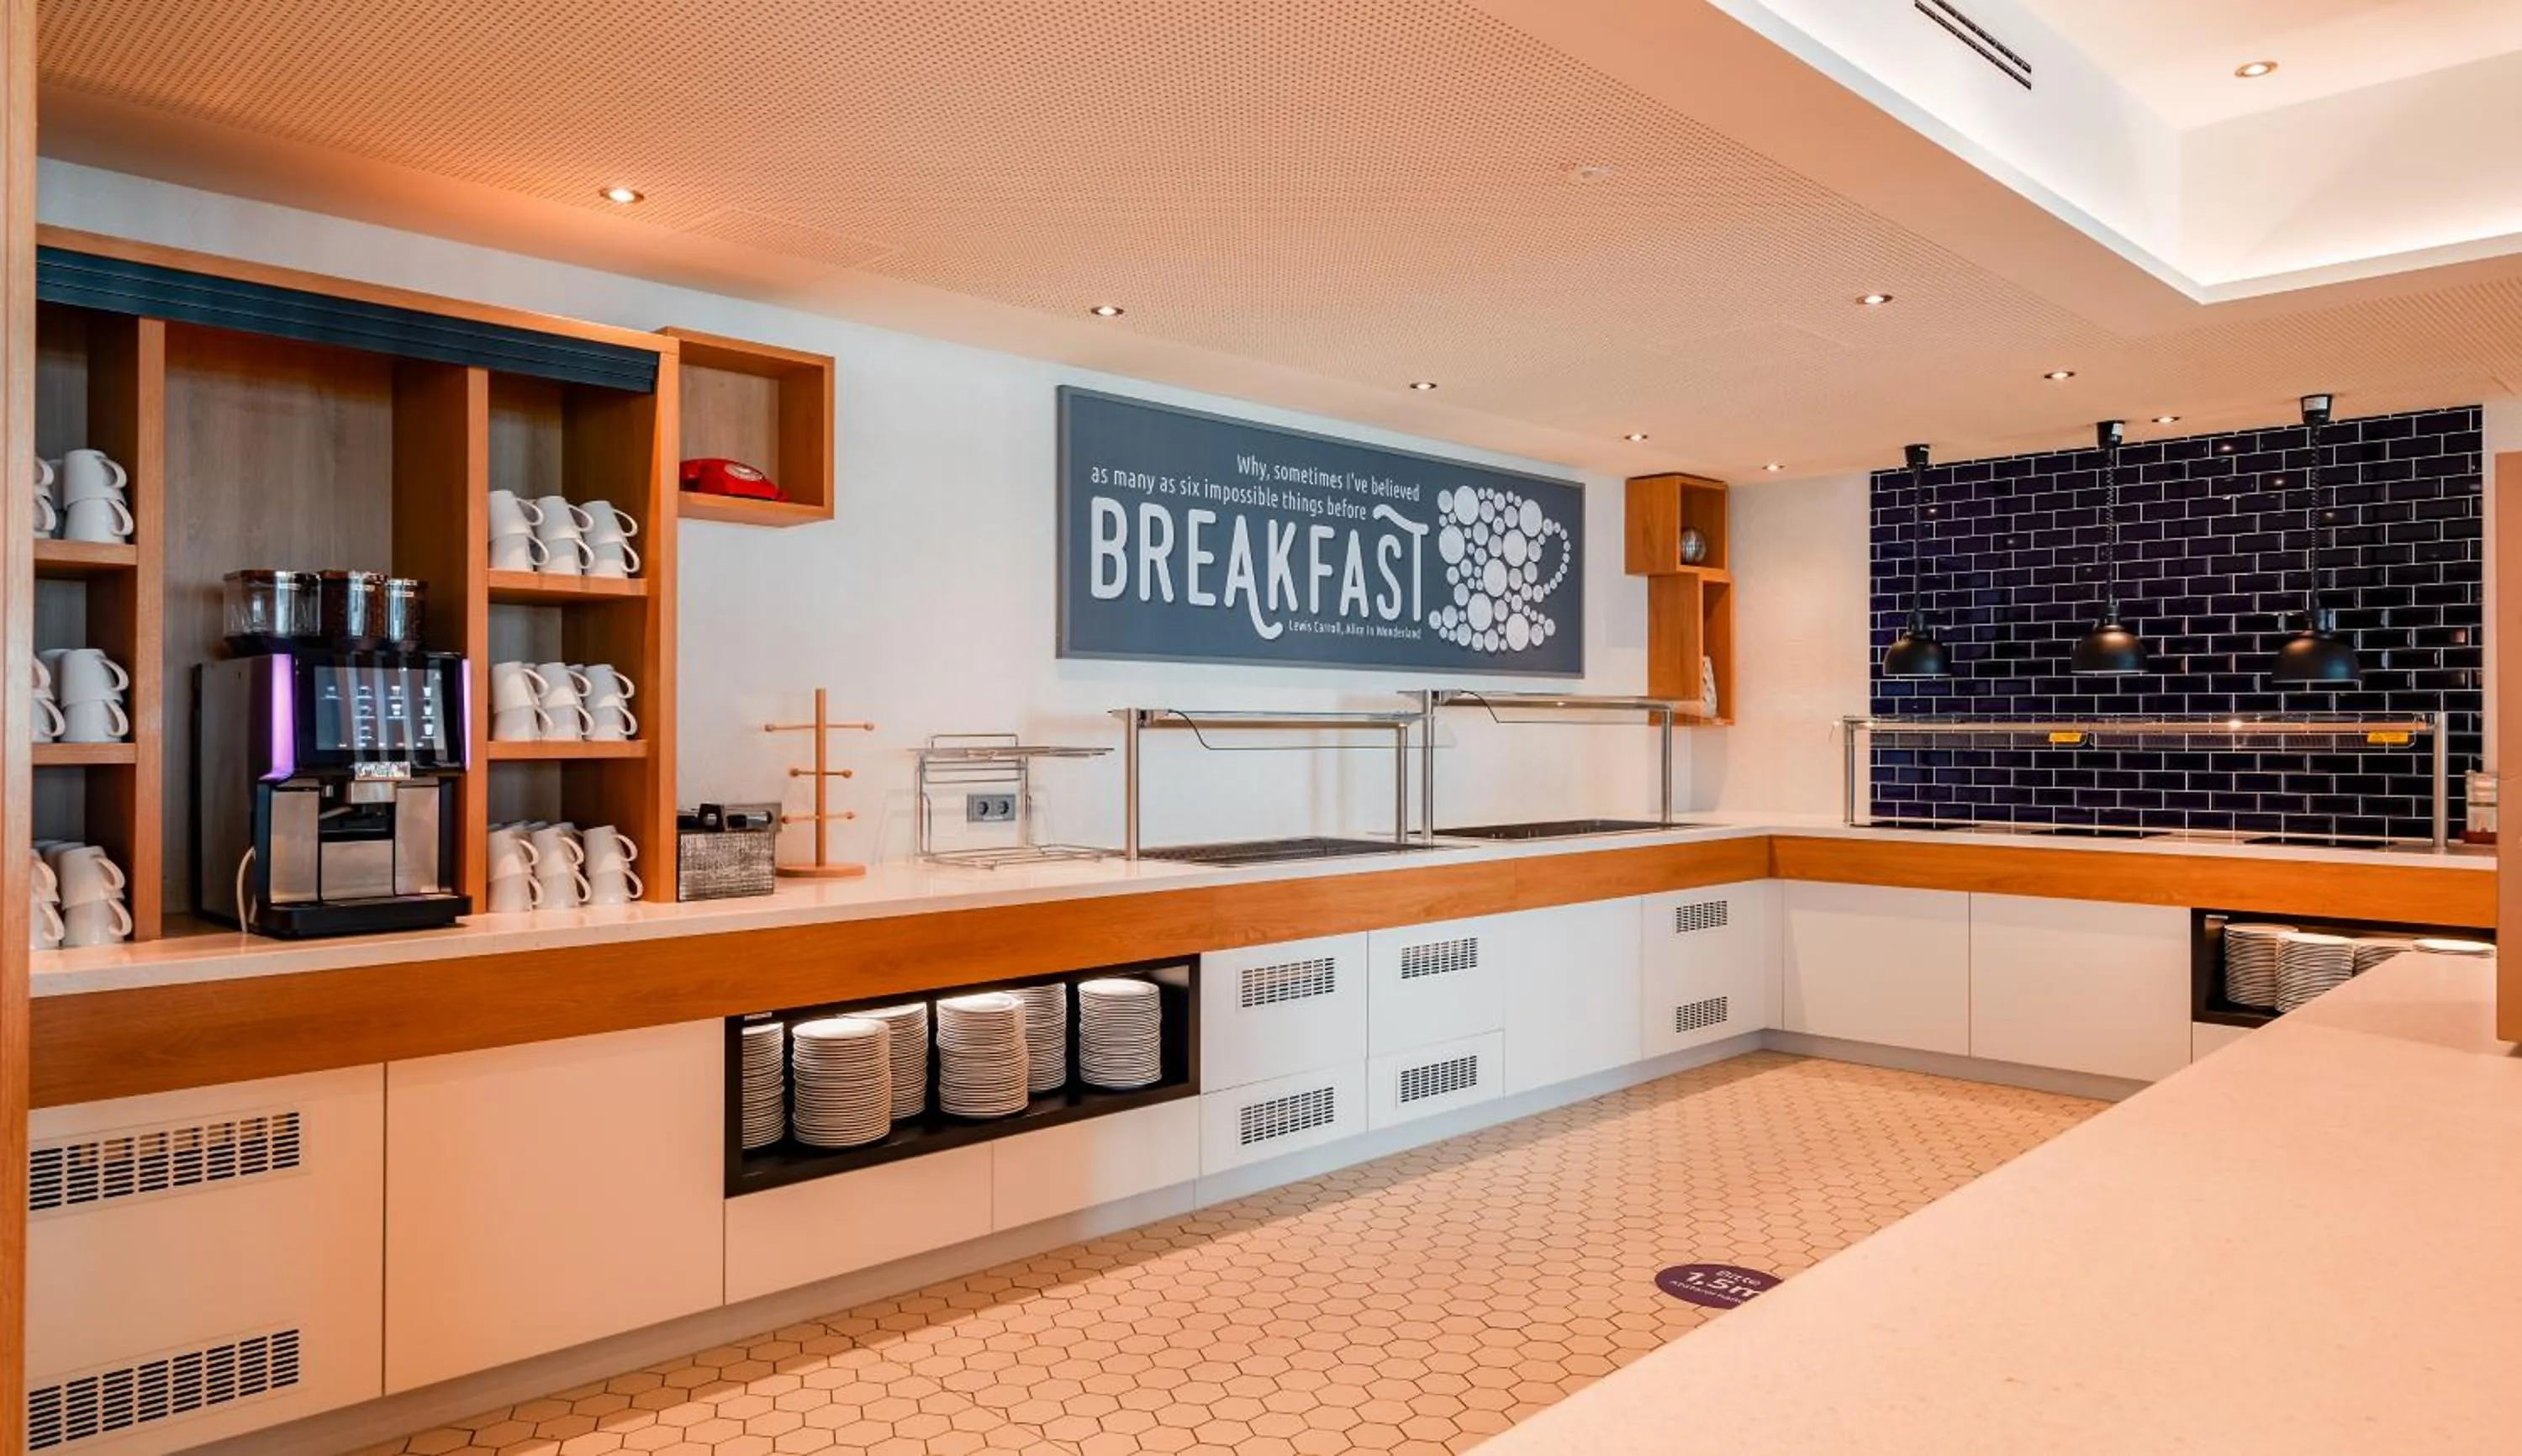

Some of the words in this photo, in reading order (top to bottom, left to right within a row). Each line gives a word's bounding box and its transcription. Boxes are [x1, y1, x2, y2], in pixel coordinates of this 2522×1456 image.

[1091, 467, 1109, 484] as
[1114, 470, 1156, 494] many
[1159, 477, 1177, 494] as
[1180, 476, 1200, 497] six
[1204, 478, 1279, 509] impossible
[1282, 491, 1324, 517] things
[1327, 495, 1367, 520] before
[1237, 454, 1270, 482] Why,
[1274, 464, 1343, 488] sometimes
[1346, 472, 1368, 494] I've
[1371, 476, 1420, 503] believed
[1090, 496, 1429, 641] BREAKFAST
[1288, 619, 1312, 633] Lewis
